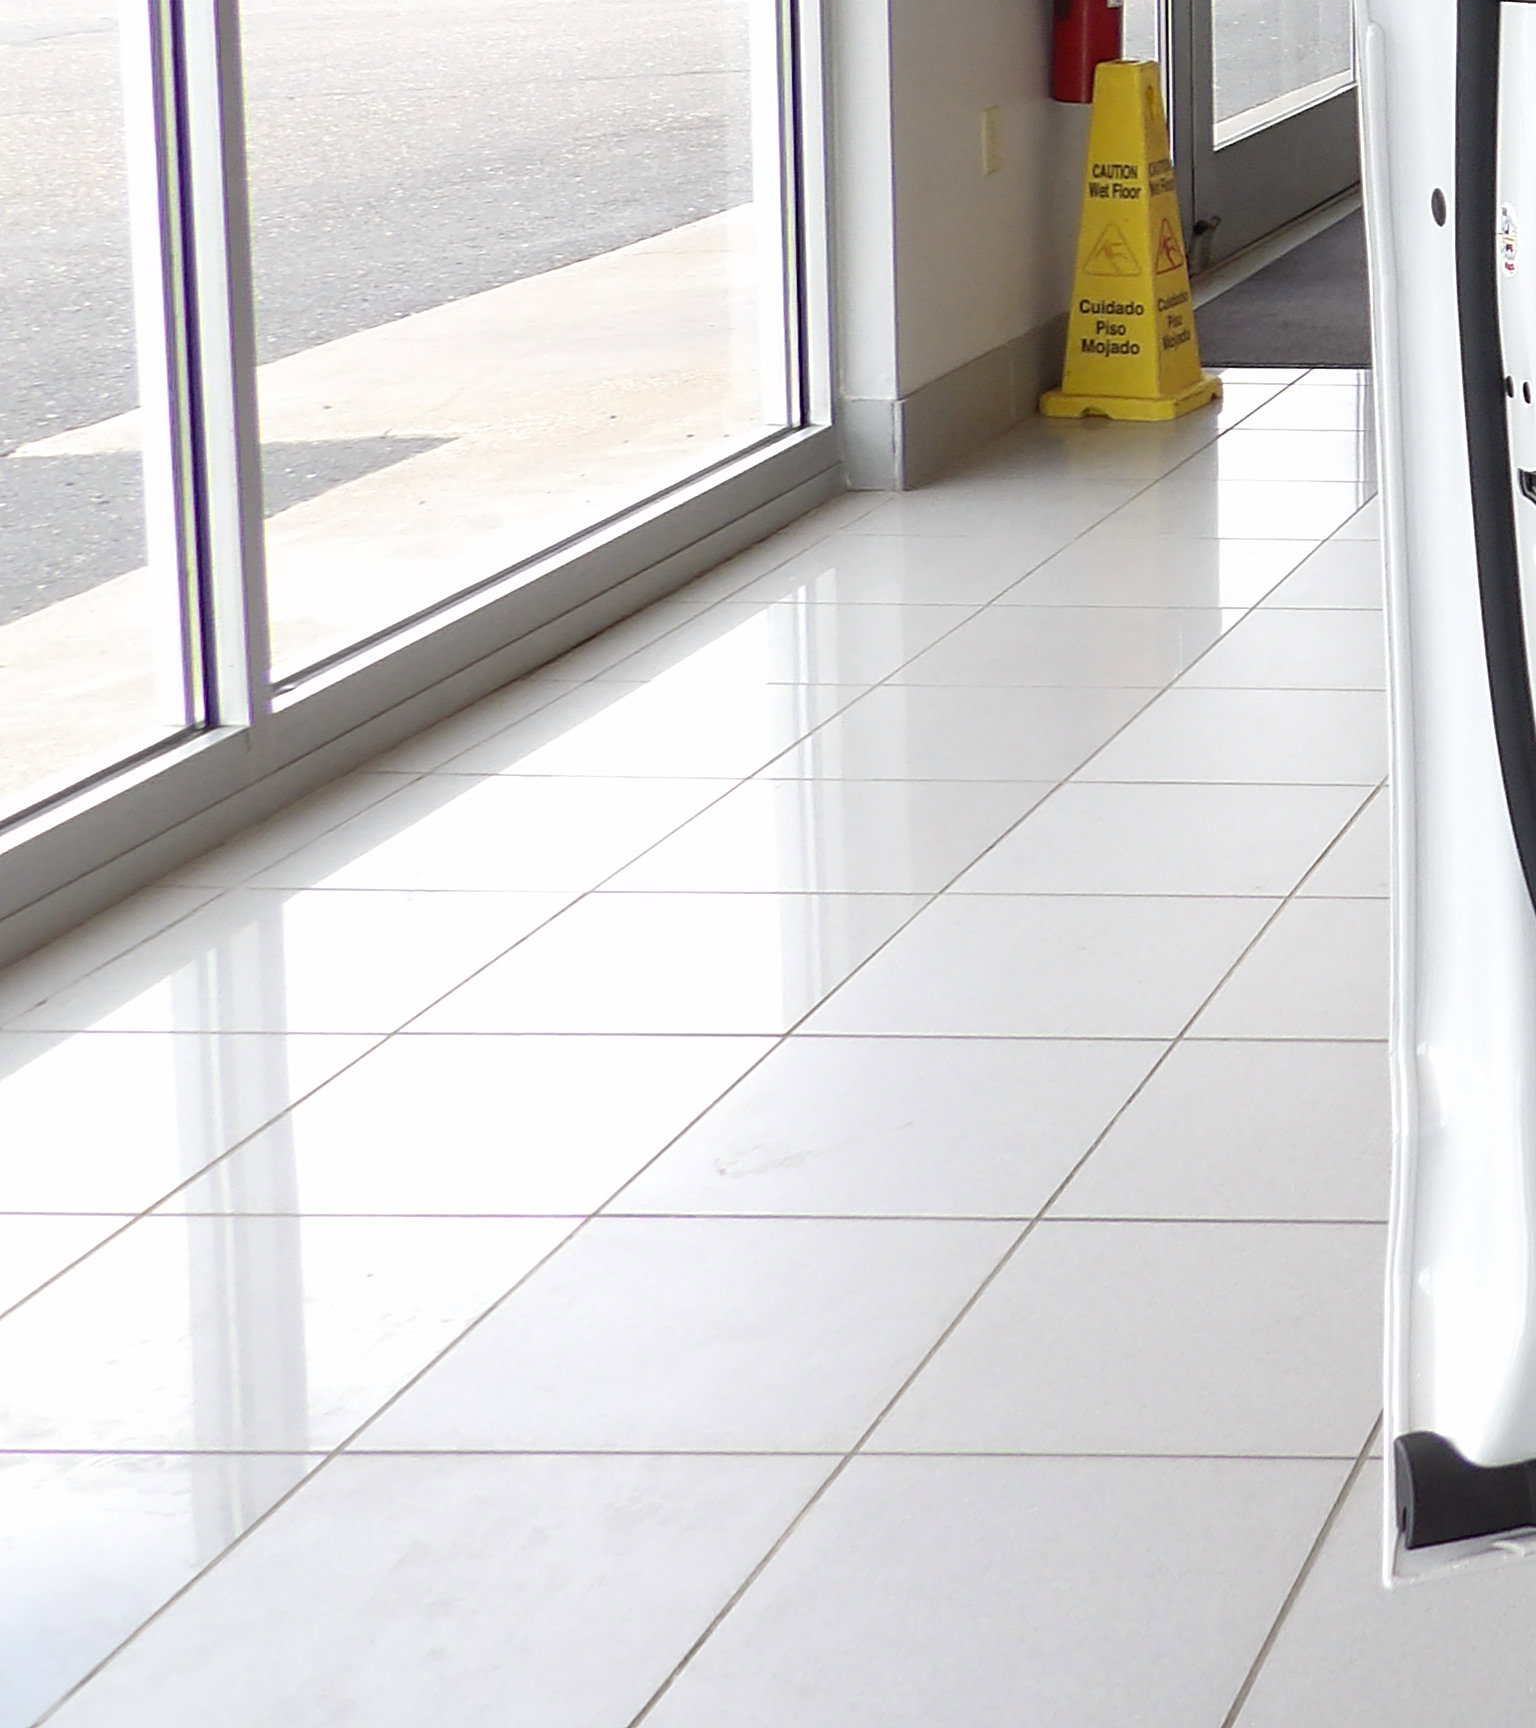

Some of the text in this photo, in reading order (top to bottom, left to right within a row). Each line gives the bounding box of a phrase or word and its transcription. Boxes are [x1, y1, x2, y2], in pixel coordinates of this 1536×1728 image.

[1092, 164, 1138, 179] CAUTION
[1088, 182, 1109, 198] Wet
[1112, 183, 1141, 199] Floor
[1080, 299, 1144, 315] Cuidado
[1096, 320, 1126, 336] Piso
[1082, 338, 1140, 357] Mojado
